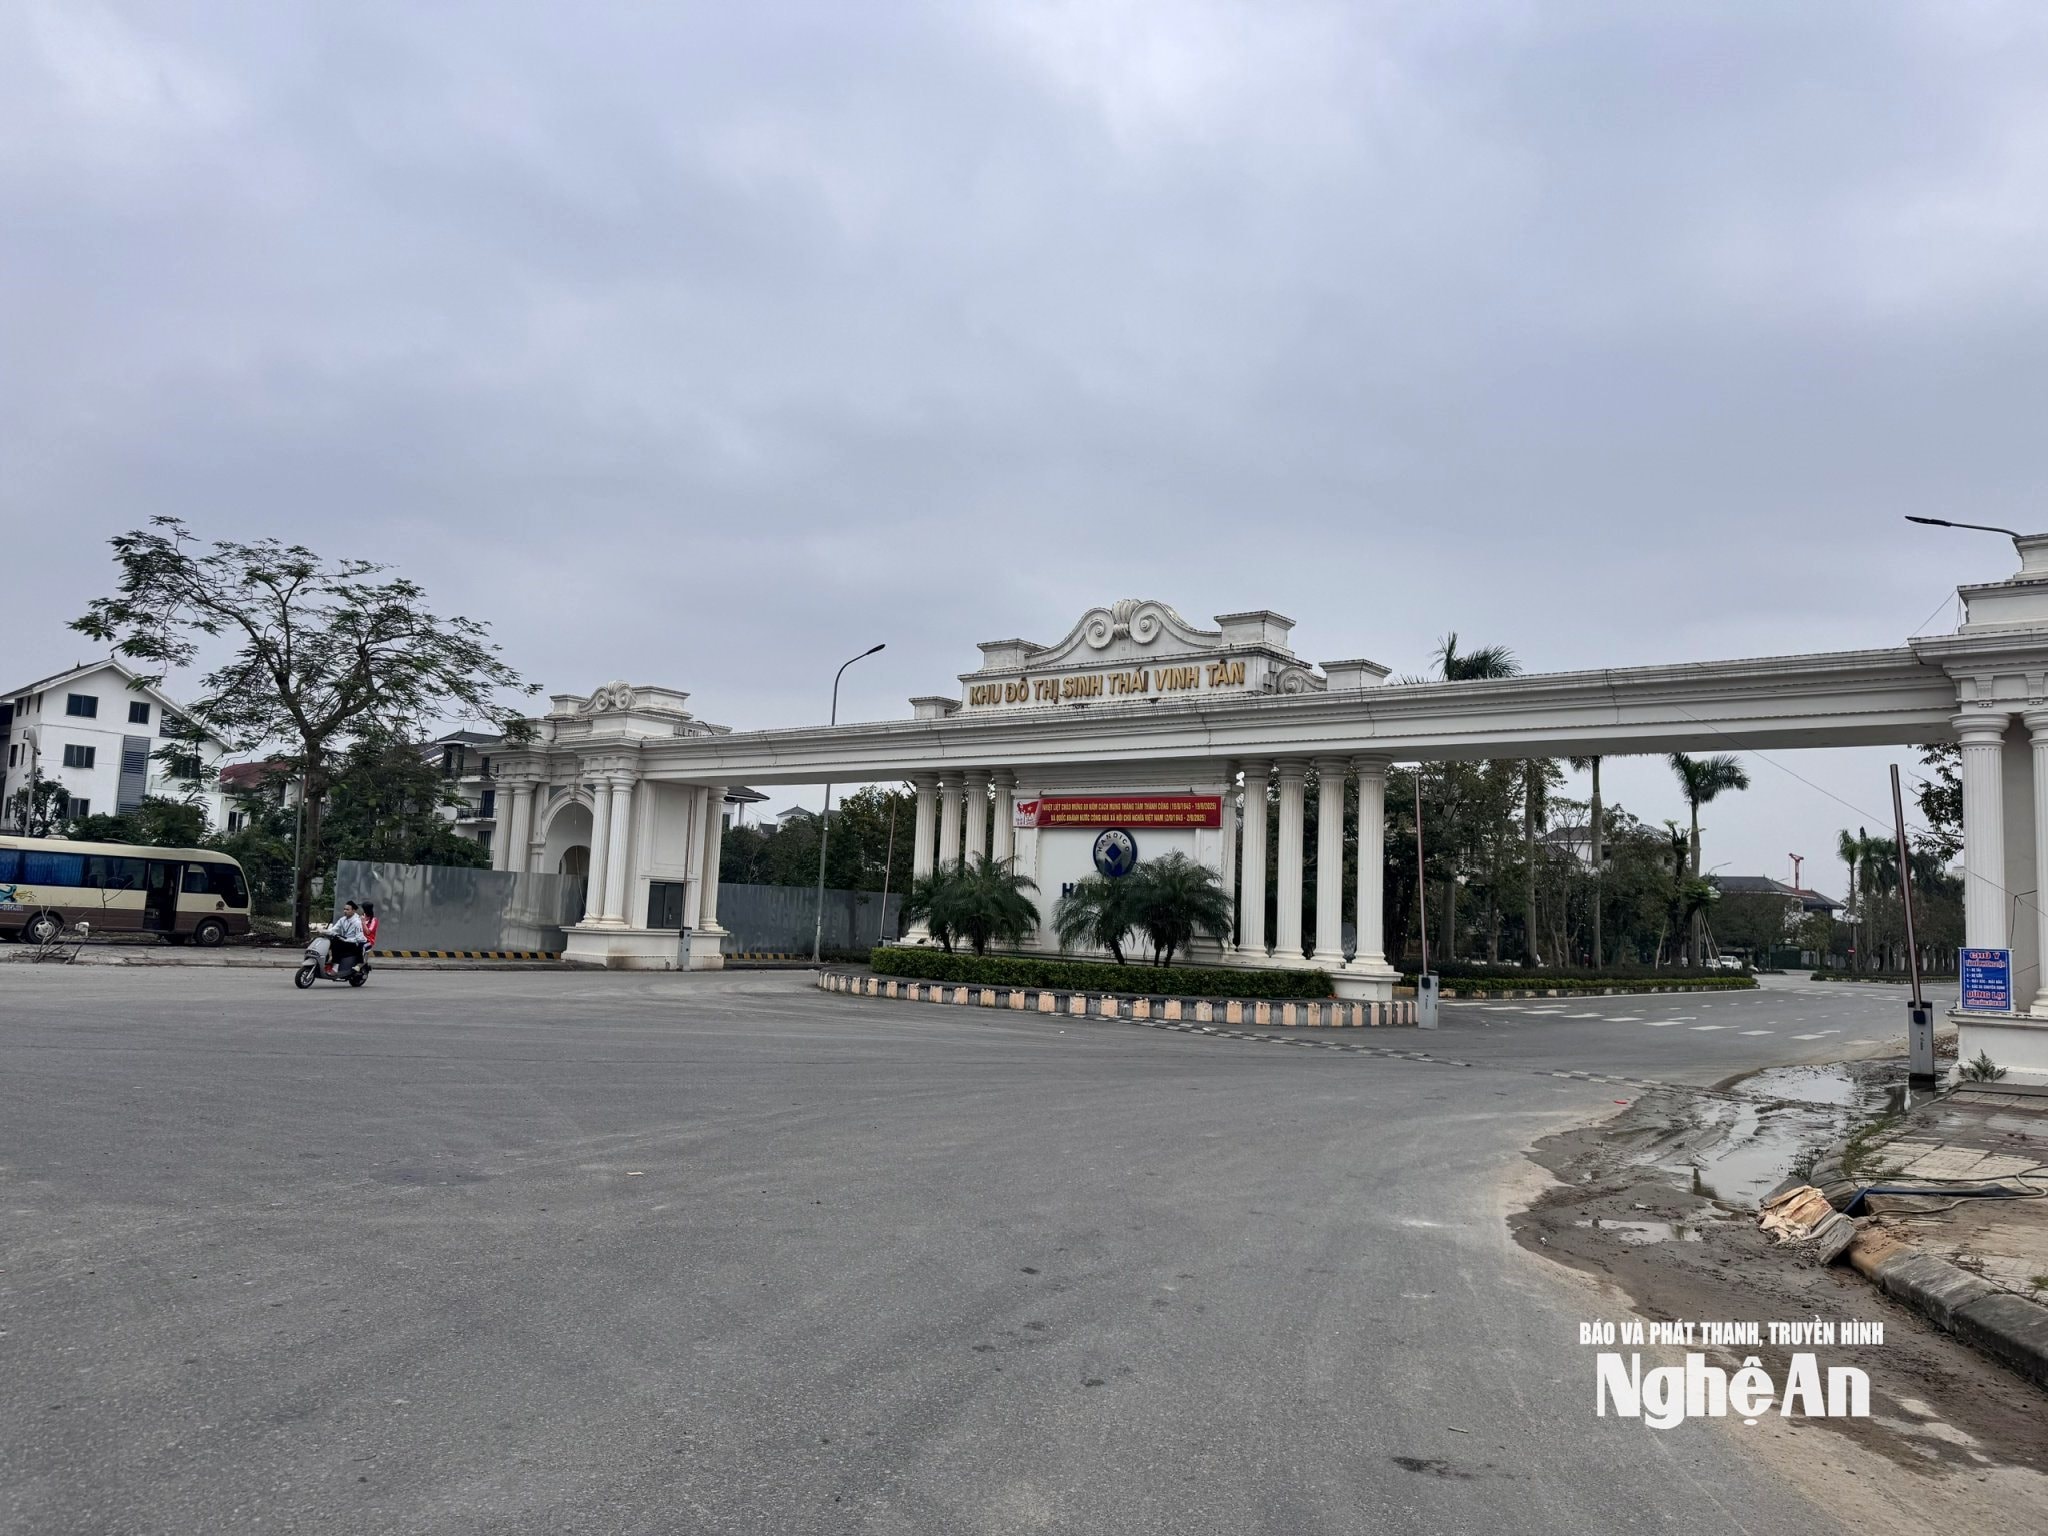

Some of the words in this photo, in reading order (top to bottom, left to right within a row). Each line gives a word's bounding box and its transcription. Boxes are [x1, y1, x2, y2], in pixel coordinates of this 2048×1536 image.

[970, 683, 1002, 705] KHU
[1005, 677, 1029, 703] ĐÔ
[1033, 678, 1060, 704] THỊ
[1063, 674, 1103, 699] SINH
[1108, 665, 1149, 694] THÁI
[1154, 665, 1200, 691] VINH
[1206, 658, 1245, 686] TÂN
[1097, 832, 1130, 854] HANDICO
